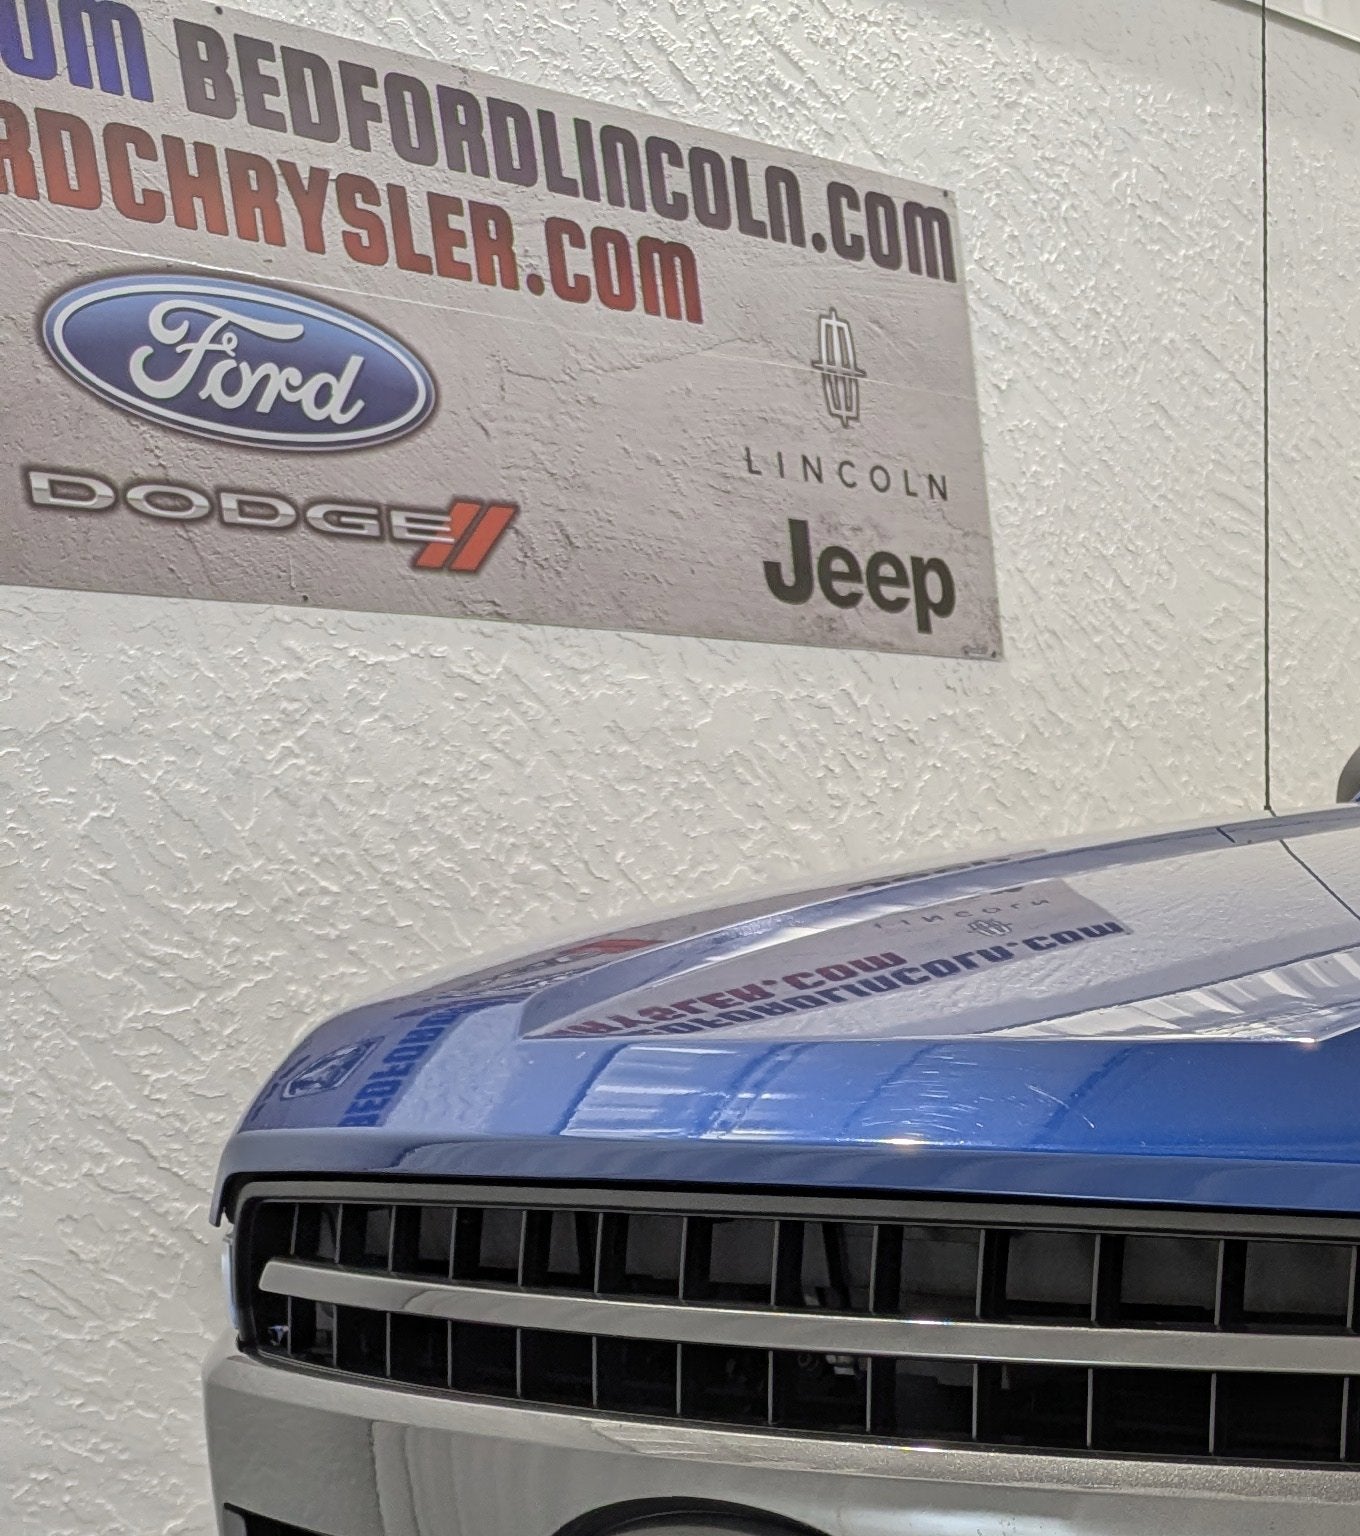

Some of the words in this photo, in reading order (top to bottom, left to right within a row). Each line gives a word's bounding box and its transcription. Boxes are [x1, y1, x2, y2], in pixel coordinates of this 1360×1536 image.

[173, 17, 958, 283] BEDFORDLINCOLN.COM
[129, 297, 365, 427] Ford
[27, 466, 456, 546] DODGE
[743, 446, 950, 502] LINCOLN
[762, 517, 957, 634] Jeep
